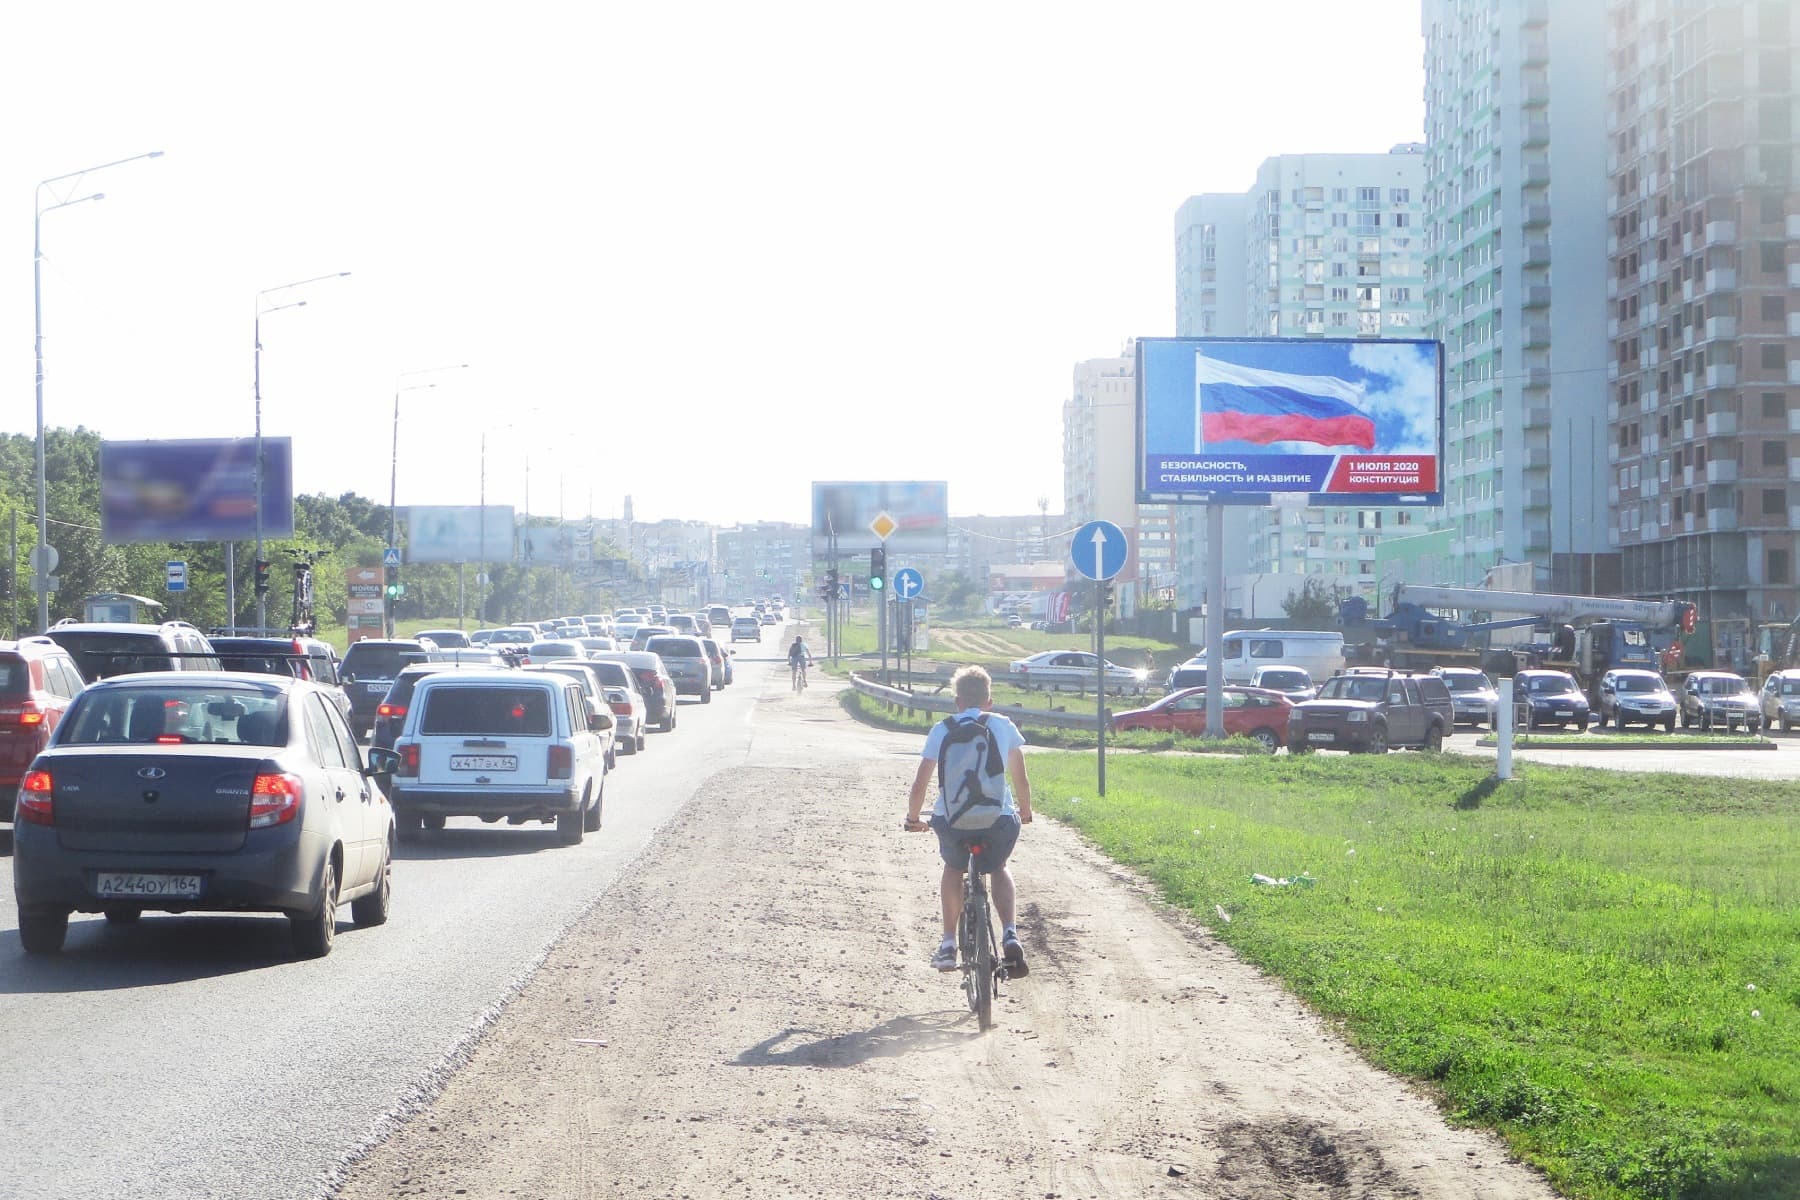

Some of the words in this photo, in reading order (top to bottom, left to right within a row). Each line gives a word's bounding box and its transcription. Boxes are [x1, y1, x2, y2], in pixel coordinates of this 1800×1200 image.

[1160, 461, 1247, 471] БЕЗОПАСНОСТЬ,
[1349, 462, 1355, 471] 1
[1357, 462, 1390, 471] ИЮЛЯ
[1393, 462, 1419, 471] 2020
[1160, 474, 1244, 483] СТАБИЛЬНОСТЬ
[1246, 474, 1254, 483] И
[1256, 474, 1312, 483] РАЗВИТИЕ
[1349, 475, 1419, 484] КОНСТИТУЦИЯ
